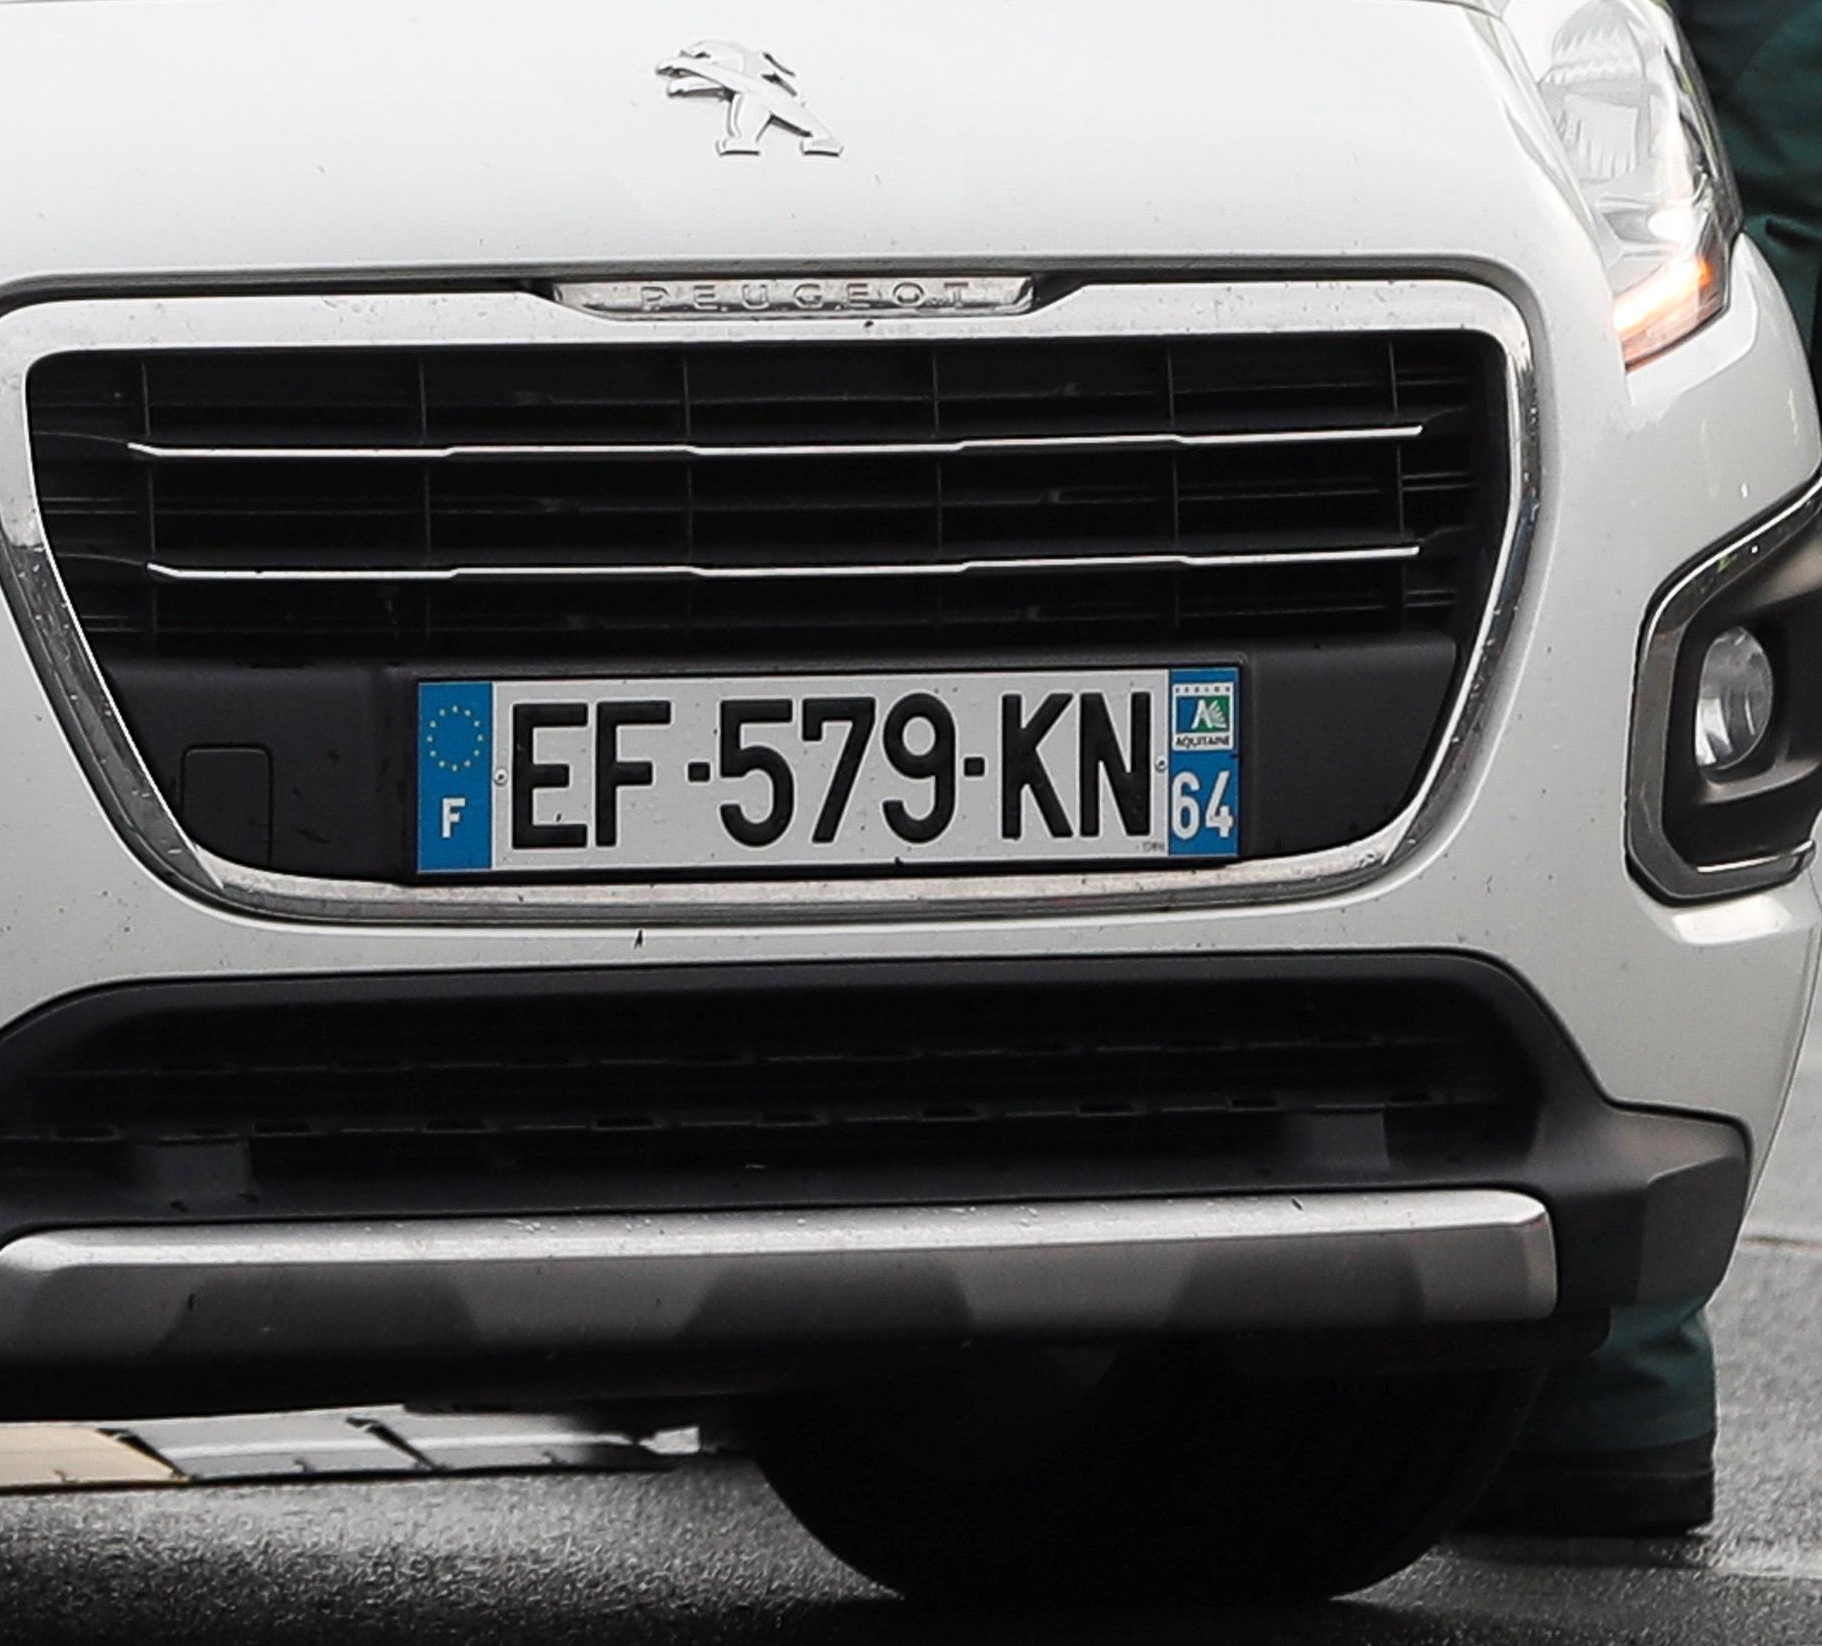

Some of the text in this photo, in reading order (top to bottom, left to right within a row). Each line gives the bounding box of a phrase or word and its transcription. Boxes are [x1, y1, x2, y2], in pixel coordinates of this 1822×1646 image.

[640, 281, 970, 312] PEUGEOT
[441, 691, 1152, 849] F EF-579-KN
[1171, 769, 1234, 840] 64
